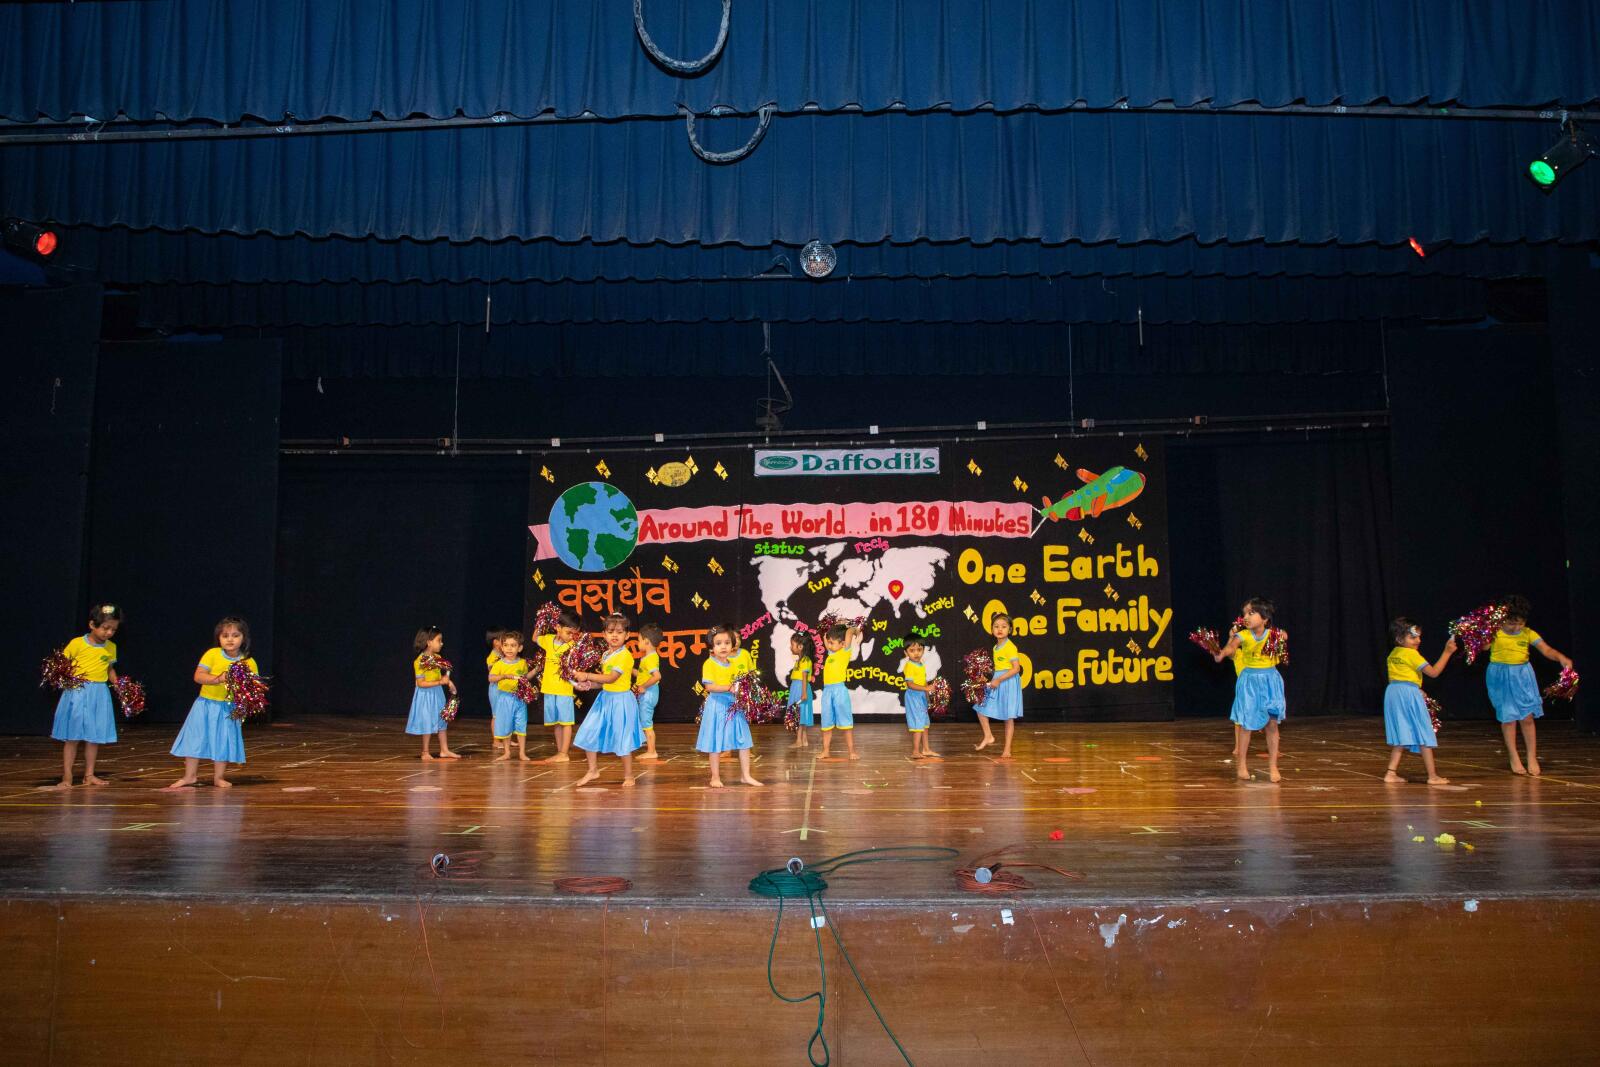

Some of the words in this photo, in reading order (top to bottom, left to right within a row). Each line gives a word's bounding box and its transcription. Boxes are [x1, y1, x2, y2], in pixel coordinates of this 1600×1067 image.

[802, 452, 936, 472] Daffodils
[638, 509, 729, 542] Around
[733, 508, 774, 536] The
[781, 507, 845, 536] World
[896, 504, 940, 533] 180
[948, 505, 1030, 535] Minutes
[754, 541, 805, 555] status
[854, 536, 890, 554] reels
[957, 547, 1027, 585] One
[1043, 542, 1159, 583] Earth
[807, 576, 833, 594] fun
[923, 595, 955, 615] travel
[871, 618, 888, 632] joy
[981, 598, 1048, 638] One
[1056, 594, 1173, 649] Family
[881, 622, 941, 656] advture
[1077, 648, 1174, 686] Future
[846, 666, 908, 691] periences
